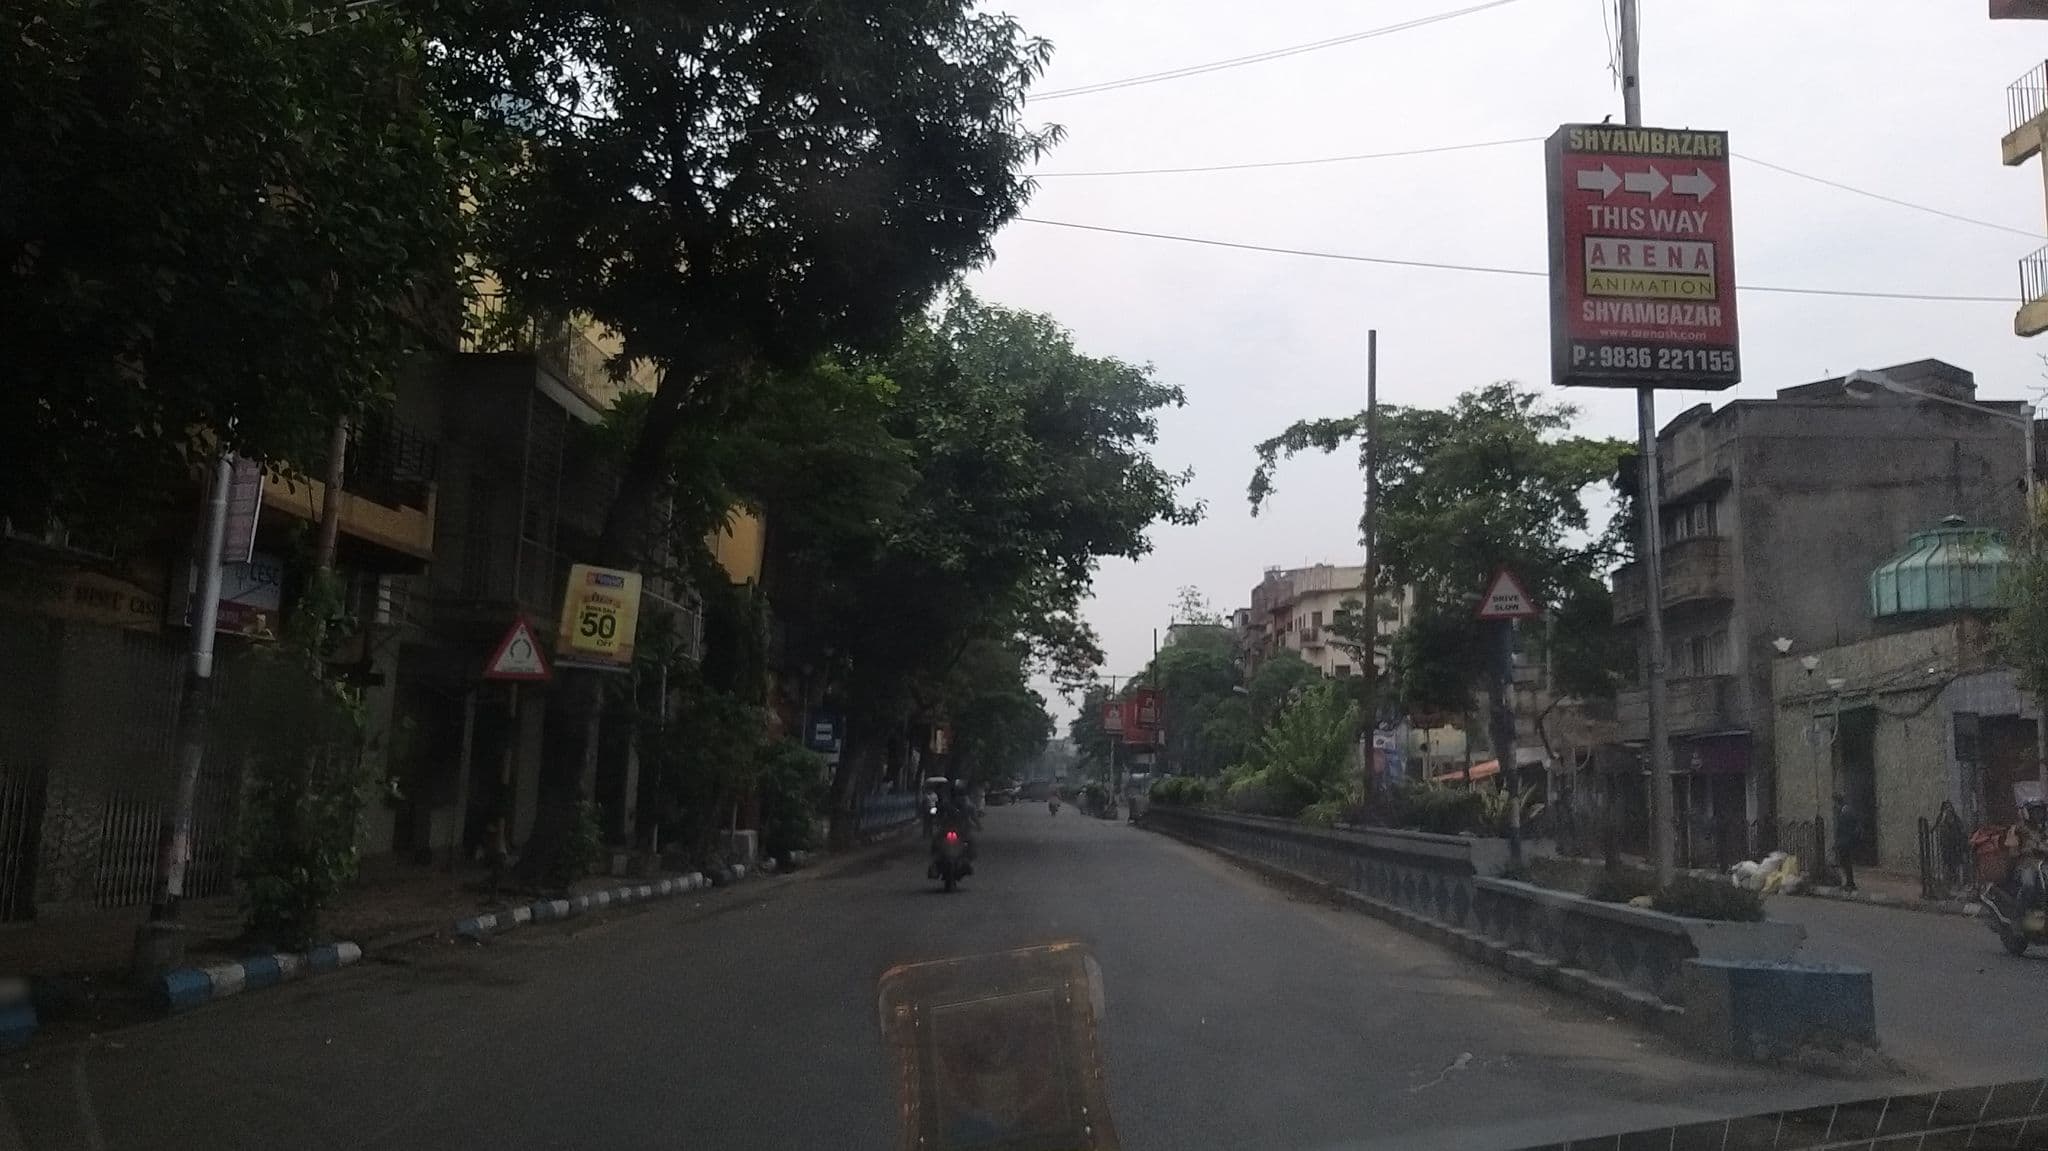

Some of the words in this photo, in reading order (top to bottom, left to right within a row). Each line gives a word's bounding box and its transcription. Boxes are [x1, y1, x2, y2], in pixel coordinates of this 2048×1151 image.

[1569, 128, 1723, 157] SHYAMBAZAR
[1587, 204, 1646, 232] THIS
[1650, 209, 1709, 234] WAY
[1590, 242, 1710, 269] ARENA
[1591, 278, 1713, 296] ANIMATION
[1582, 299, 1723, 327] SHYAMBAZAR
[1600, 345, 1653, 369] 9836
[1657, 349, 1735, 373] 221155
[580, 612, 616, 639] 50
